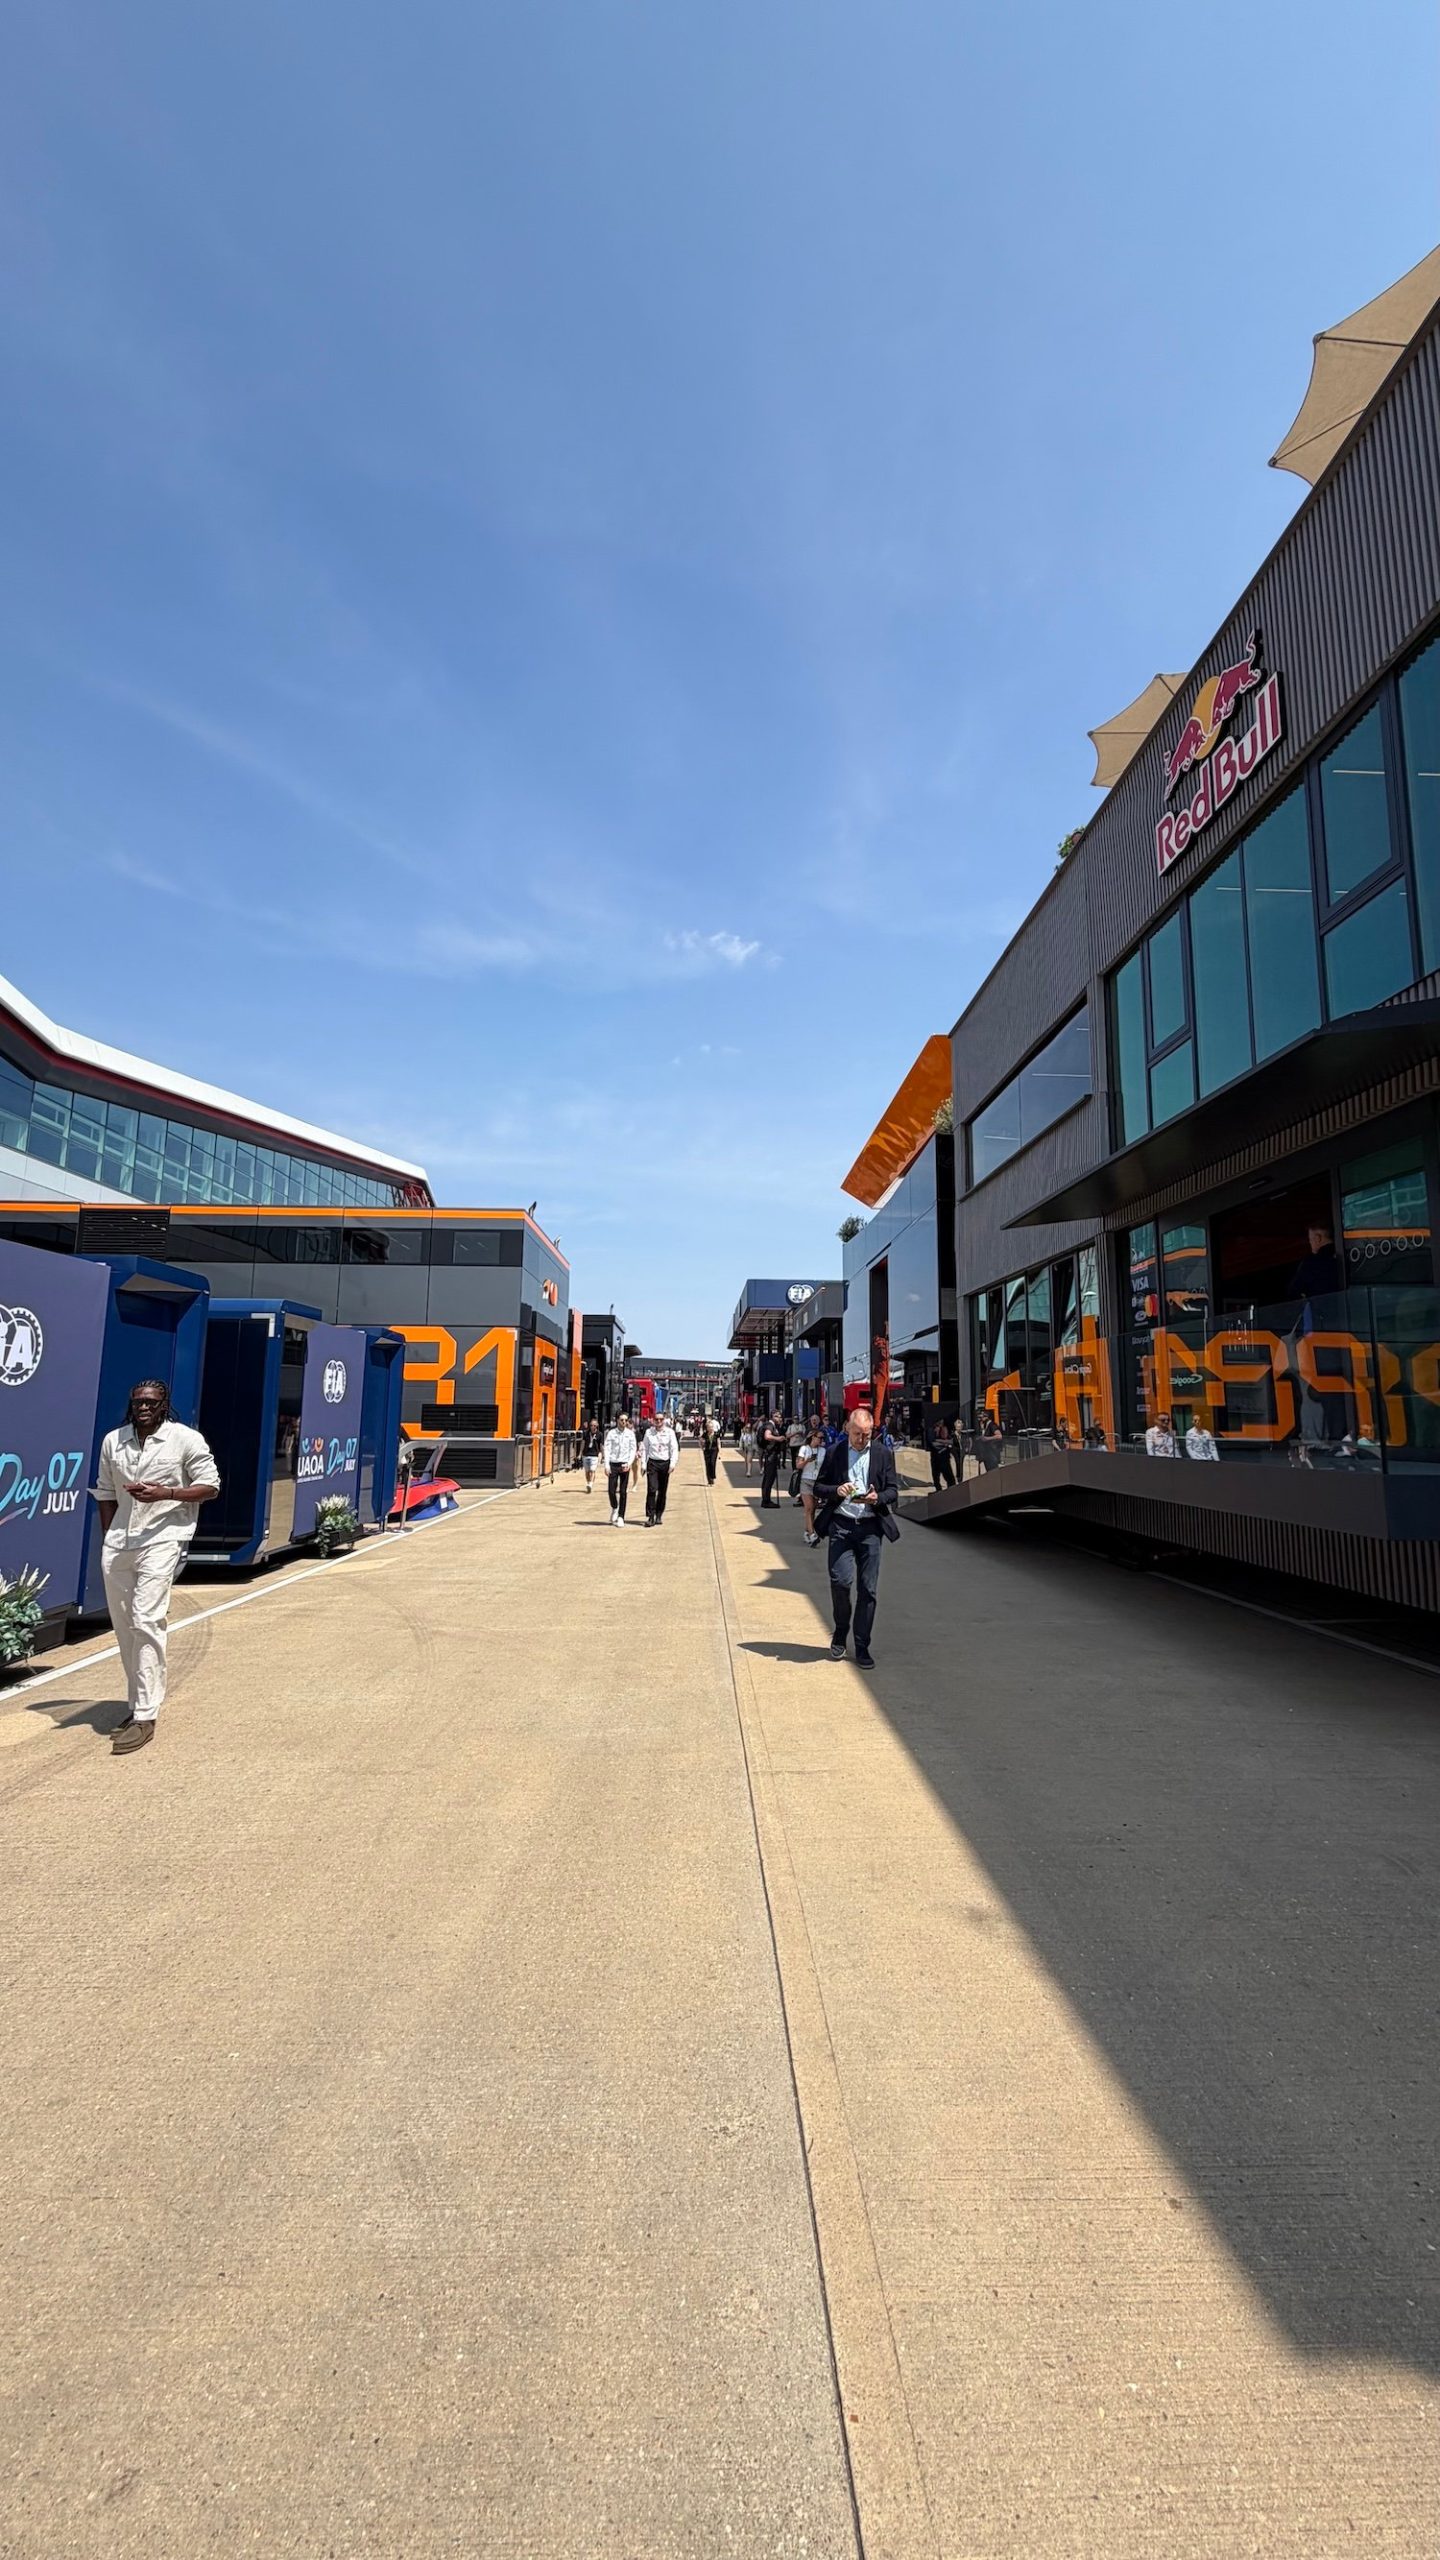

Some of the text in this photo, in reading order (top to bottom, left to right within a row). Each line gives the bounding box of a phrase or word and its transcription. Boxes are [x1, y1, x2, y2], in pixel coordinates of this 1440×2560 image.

[1156, 671, 1282, 877] Red Bull
[790, 1286, 811, 1300] FIA
[1131, 1276, 1149, 1293] VISA
[324, 1368, 344, 1394] FIA
[297, 1454, 324, 1477] UAOA
[326, 1438, 357, 1475] Day 07
[48, 1452, 84, 1490] 07
[43, 1490, 80, 1514] JULY
